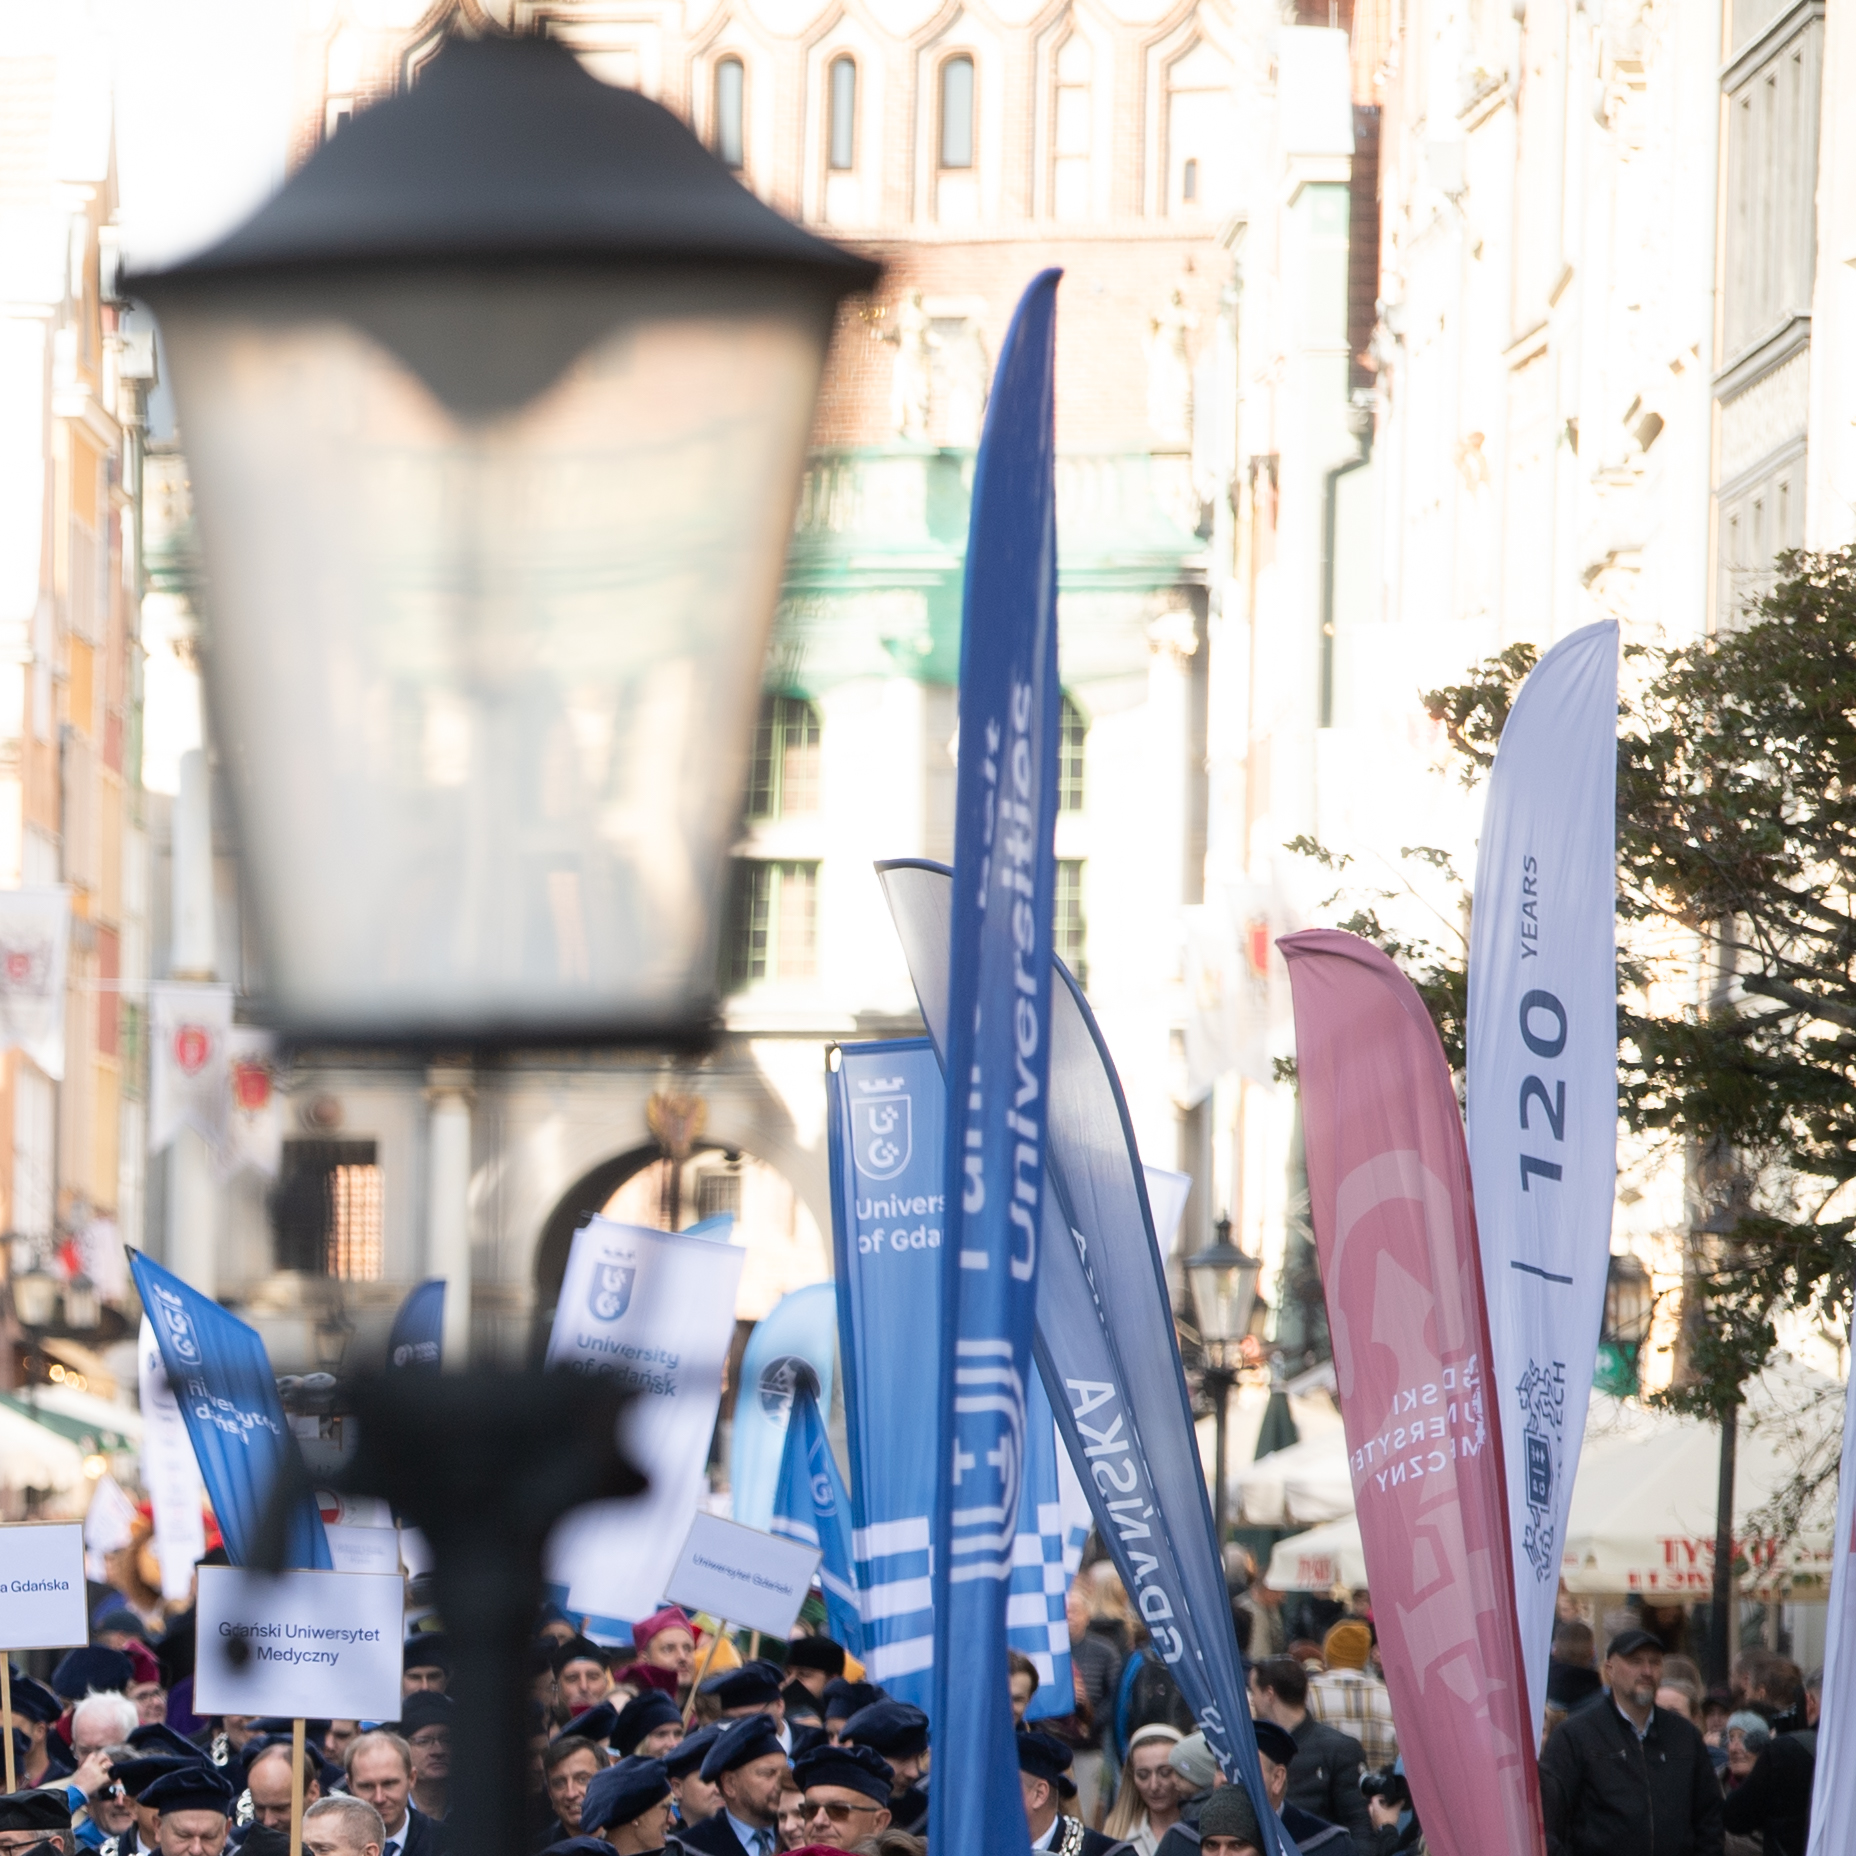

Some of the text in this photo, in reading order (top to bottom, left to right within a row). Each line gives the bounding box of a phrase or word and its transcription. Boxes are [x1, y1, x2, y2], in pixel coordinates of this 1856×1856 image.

[1519, 854, 1567, 1194] 120 YEARS
[856, 1193, 945, 1221] Univers
[858, 1224, 944, 1255] of Gda
[10, 1578, 70, 1594] Gdańska
[218, 1621, 380, 1644] Gdański Uniwersytet
[257, 1647, 340, 1667] Medyczny
